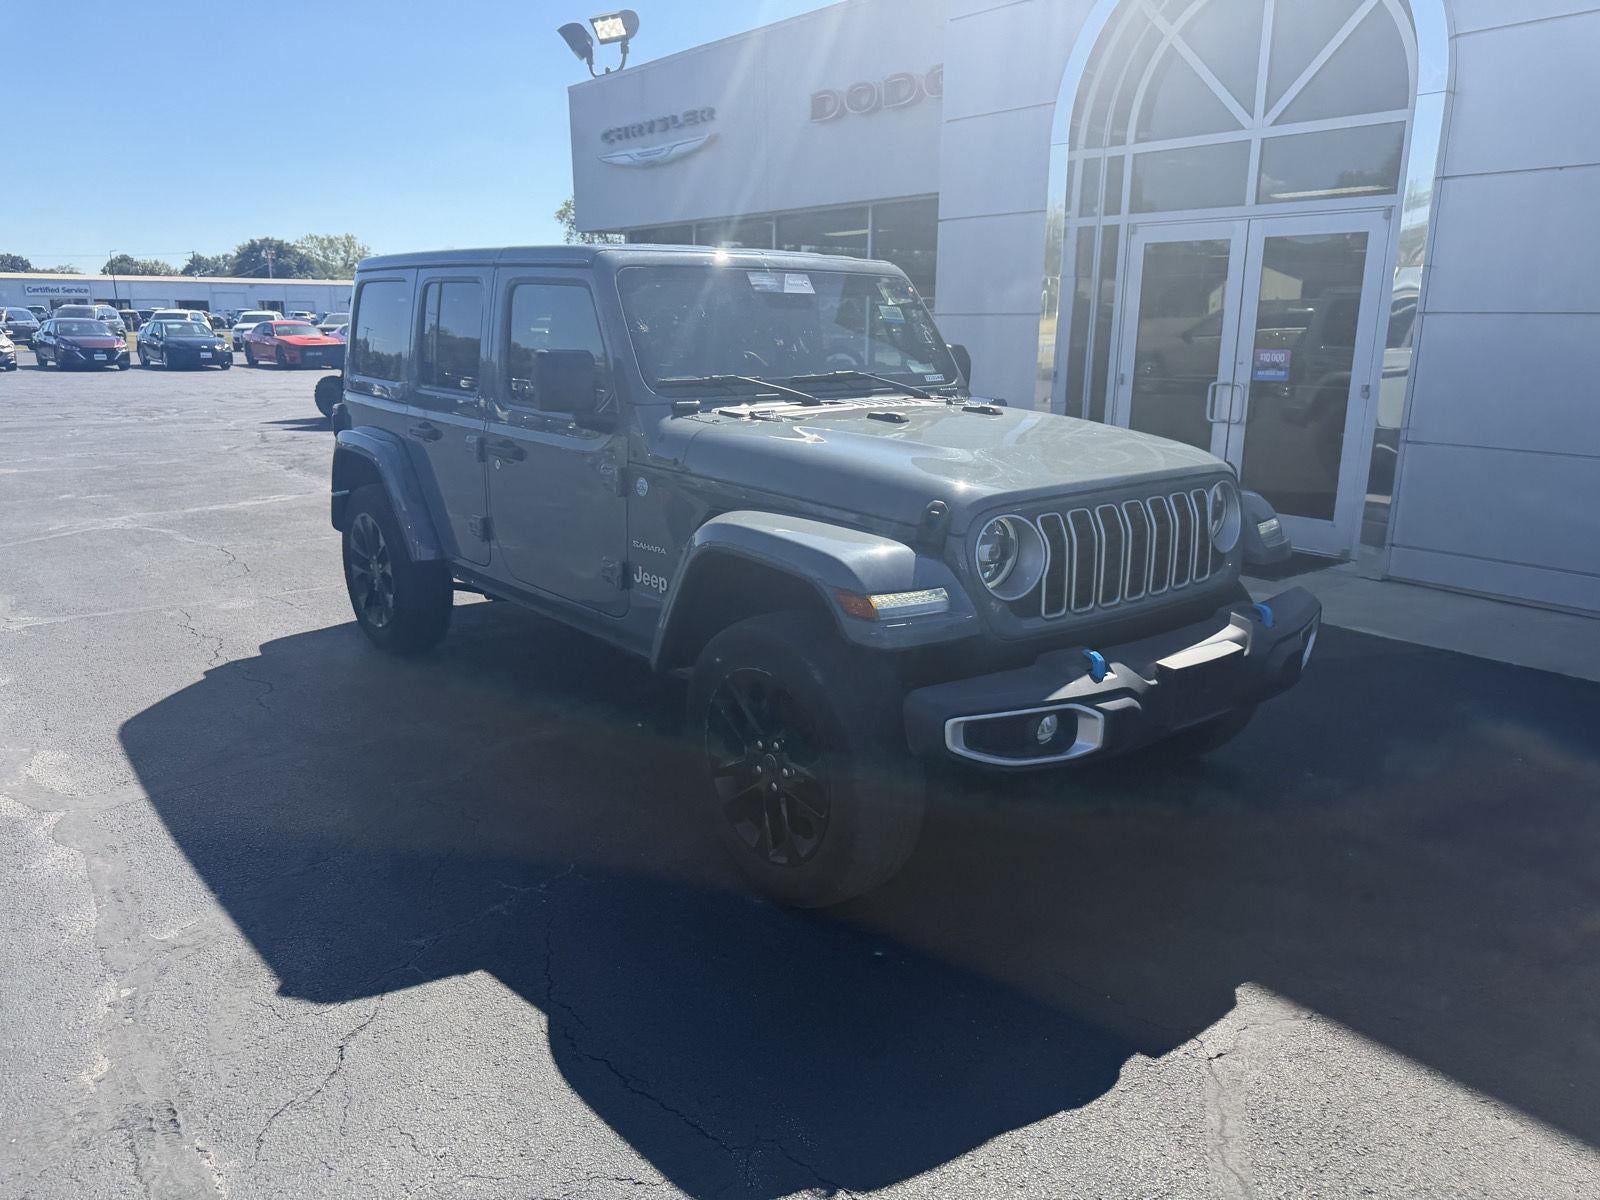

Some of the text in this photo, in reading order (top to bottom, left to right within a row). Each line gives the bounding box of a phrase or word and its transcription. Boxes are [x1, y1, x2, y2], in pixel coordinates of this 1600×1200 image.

[27, 285, 89, 295] Certified Service
[632, 541, 667, 555] SAHARA
[633, 566, 668, 593] Jeep
